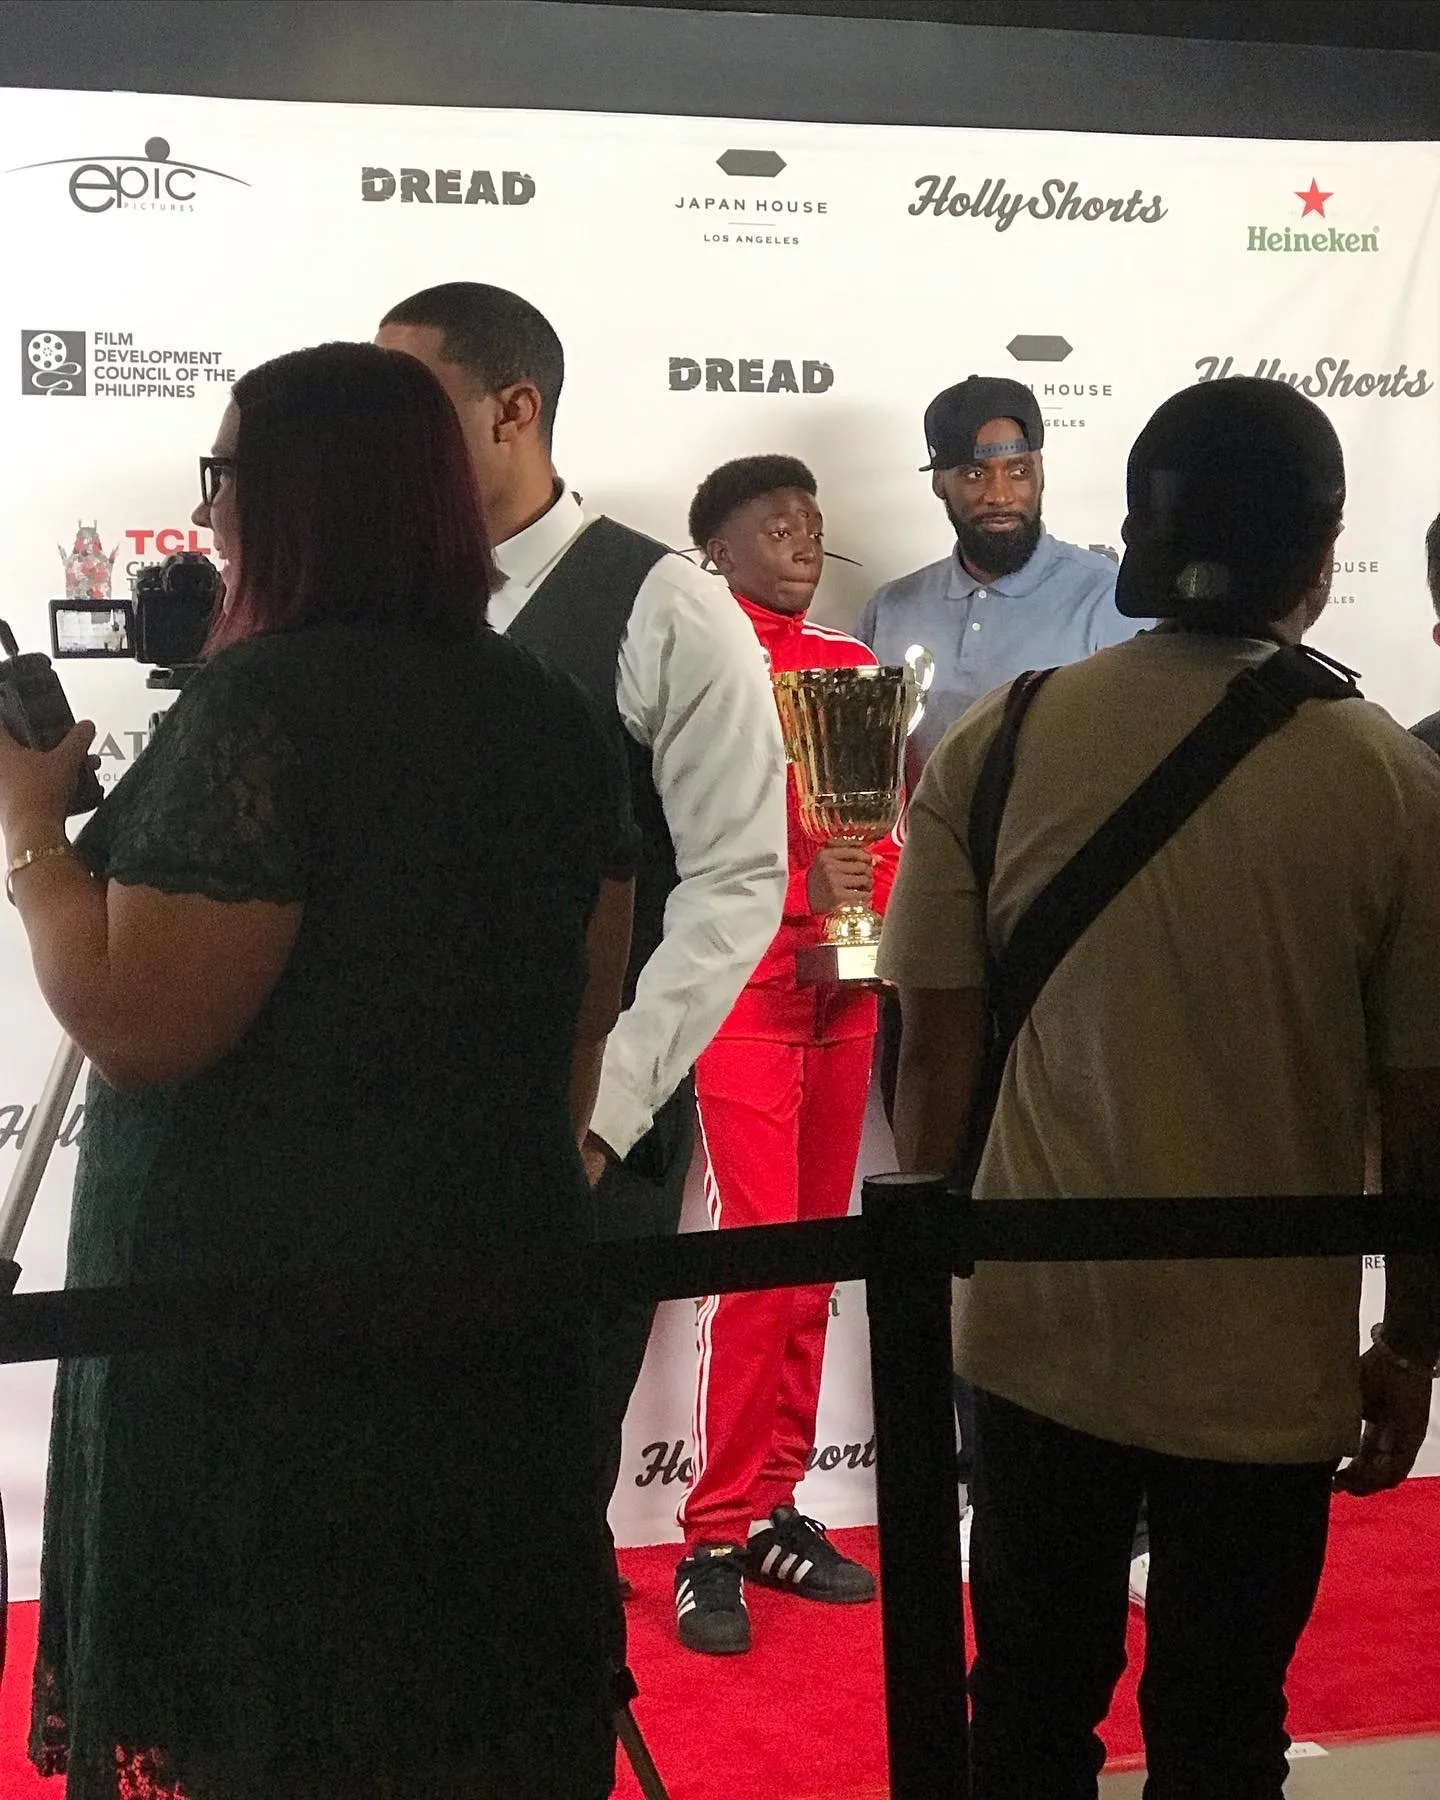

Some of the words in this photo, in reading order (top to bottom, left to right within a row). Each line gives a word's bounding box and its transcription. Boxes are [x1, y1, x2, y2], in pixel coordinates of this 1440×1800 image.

[361, 167, 536, 206] DREAD
[123, 202, 195, 213] PICTURES
[675, 197, 746, 211] JAPAN
[756, 199, 828, 214] HOUSE
[908, 174, 1169, 233] HollyShorts
[703, 234, 729, 243] LOS
[736, 235, 800, 245] ANGELES
[1246, 225, 1380, 253] Heineken
[94, 331, 134, 346] FILM
[94, 349, 223, 365] DEVELOPMENT
[94, 366, 172, 381] COUNCIL
[175, 367, 199, 382] OF
[204, 368, 237, 382] THE
[669, 356, 834, 394] DREAD
[94, 383, 196, 399] PHILIPPINES
[1044, 383, 1113, 397] HOUSE
[1043, 419, 1086, 428] GELES
[125, 528, 212, 557] TCL
[1332, 561, 1380, 573] OUSE
